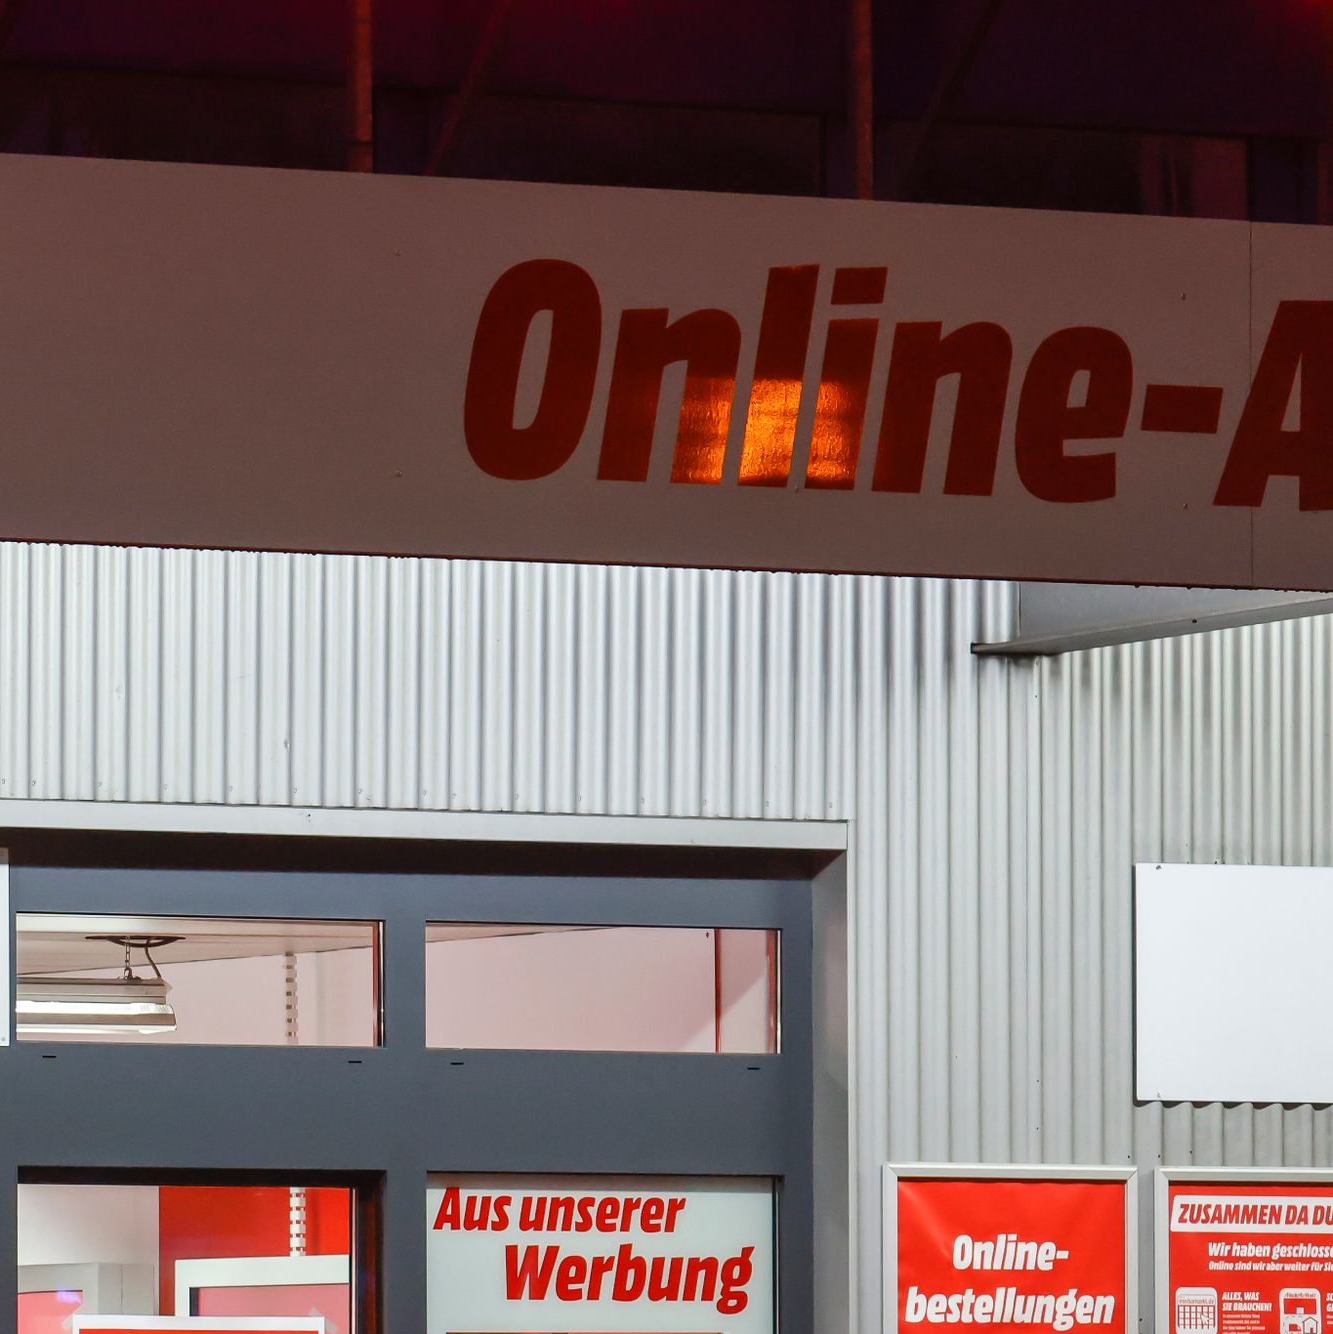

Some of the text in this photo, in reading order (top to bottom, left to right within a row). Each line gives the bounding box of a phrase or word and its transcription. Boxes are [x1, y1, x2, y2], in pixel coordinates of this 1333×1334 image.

[463, 258, 1333, 511] Online-A
[434, 1187, 686, 1234] Aus unserer
[1178, 1203, 1282, 1225] ZUSAMMEN
[1285, 1205, 1308, 1226] DA
[952, 1233, 1069, 1271] Online-
[1208, 1242, 1231, 1257] Wir
[1232, 1242, 1270, 1257] haben
[504, 1244, 755, 1314] Werbung
[1209, 1261, 1233, 1271] Online
[1234, 1261, 1251, 1271] sind
[1252, 1262, 1265, 1271] wir
[1266, 1262, 1283, 1271] aber
[1284, 1262, 1309, 1272] weiter
[1310, 1262, 1323, 1272] für
[904, 1286, 1115, 1331] bestellungen
[1222, 1292, 1260, 1301] ALLES, WAS
[1222, 1303, 1272, 1312] SIE BRAUCHEN!
